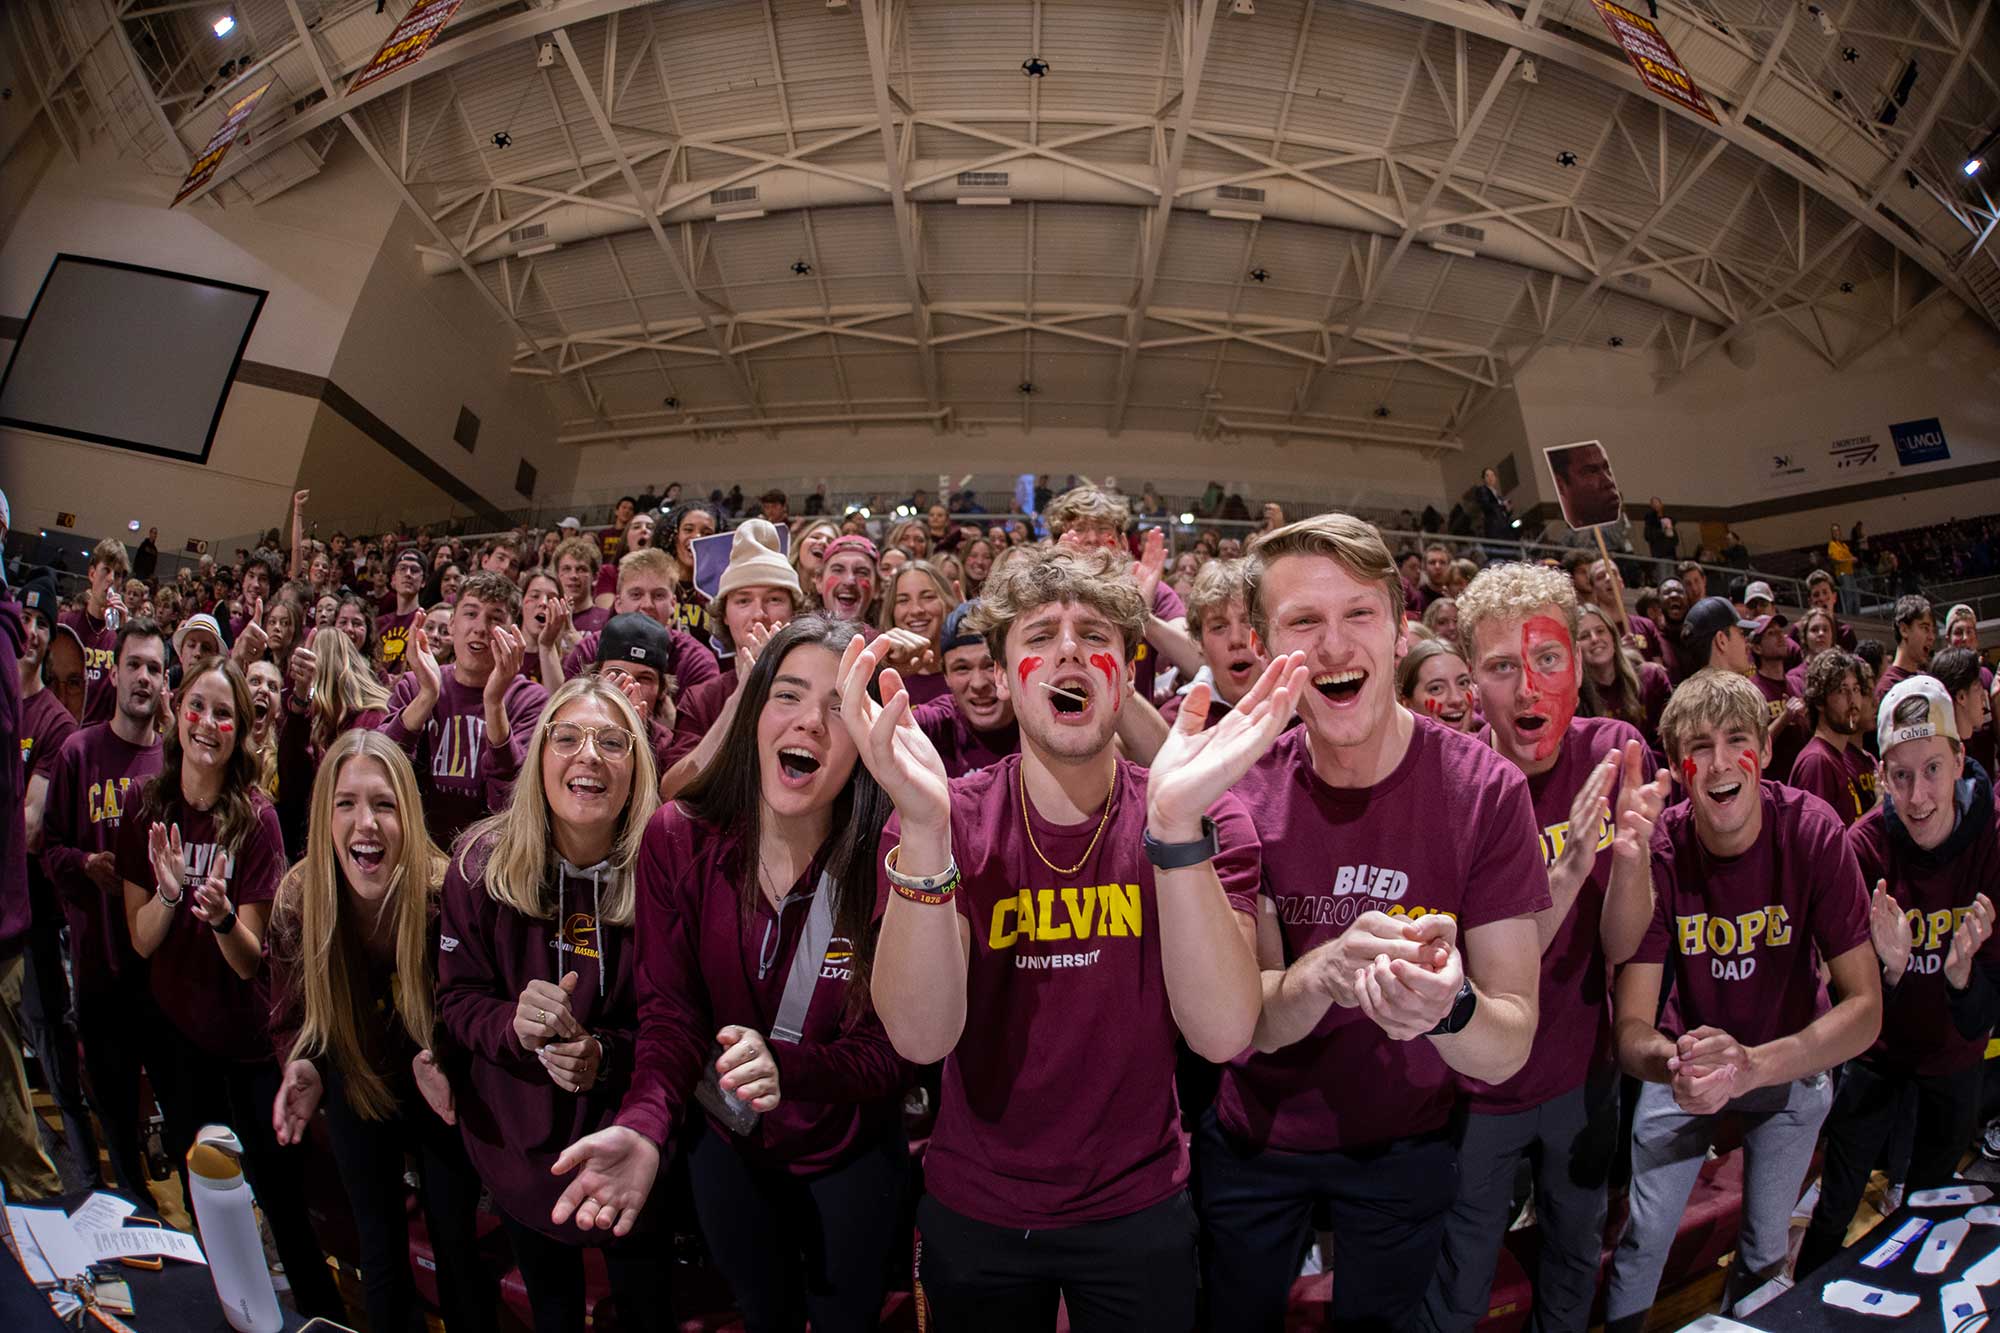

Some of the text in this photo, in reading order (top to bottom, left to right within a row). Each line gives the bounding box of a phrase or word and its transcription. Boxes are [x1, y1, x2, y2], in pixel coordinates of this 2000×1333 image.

[1900, 727, 1929, 740] Calvin
[900, 886, 917, 900] EST.
[1333, 864, 1408, 900] BLEED
[989, 883, 1142, 950] CALVIN
[1675, 904, 1792, 956] HOPE
[1015, 950, 1101, 969] UNIVERSITY
[1711, 957, 1756, 981] DAD
